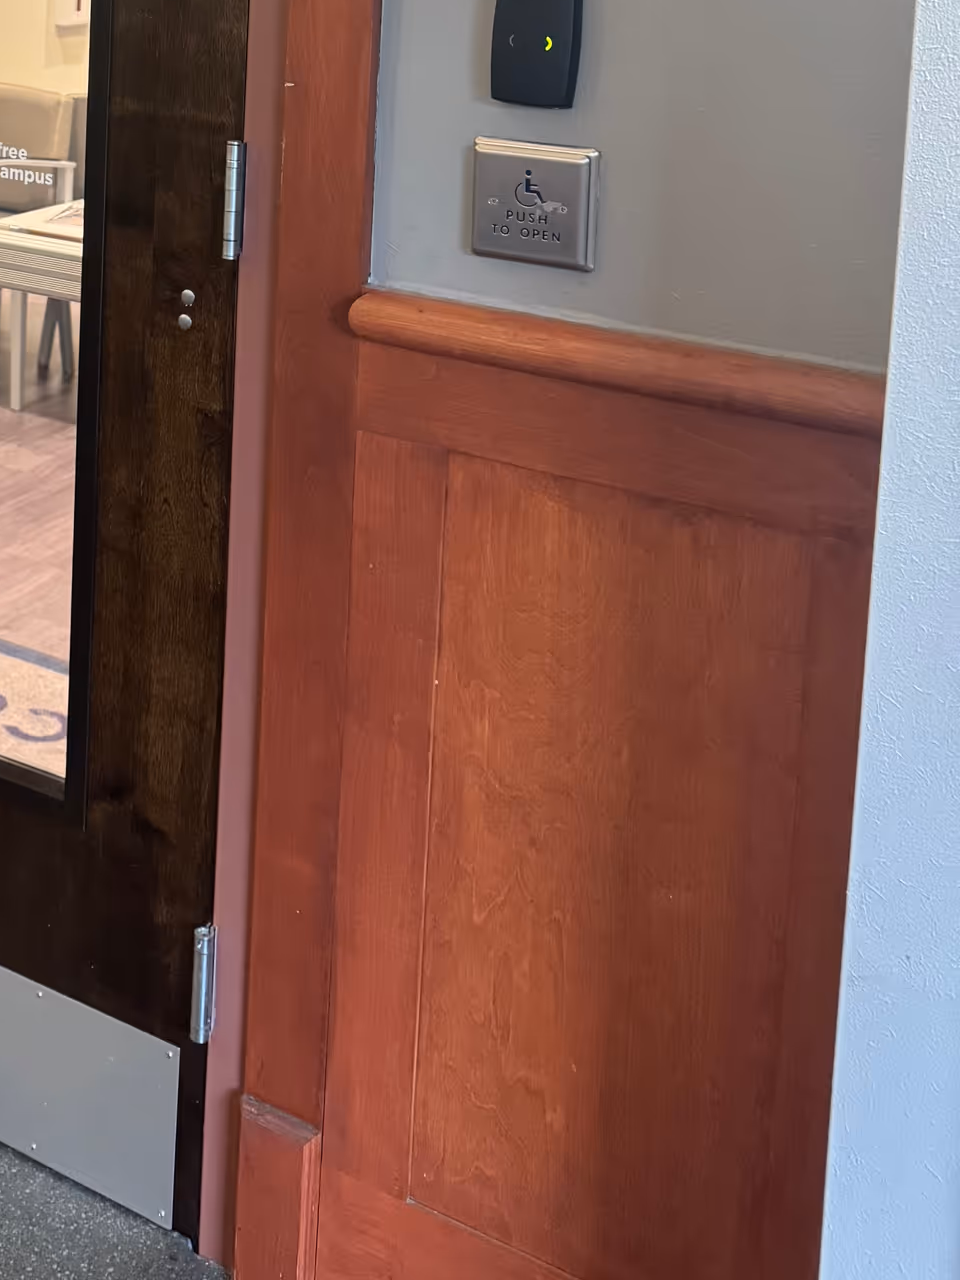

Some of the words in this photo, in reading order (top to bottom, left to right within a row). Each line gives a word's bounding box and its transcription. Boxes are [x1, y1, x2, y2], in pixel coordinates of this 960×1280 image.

[505, 209, 548, 224] PUSH
[491, 223, 510, 237] TO
[520, 227, 561, 243] OPEN
